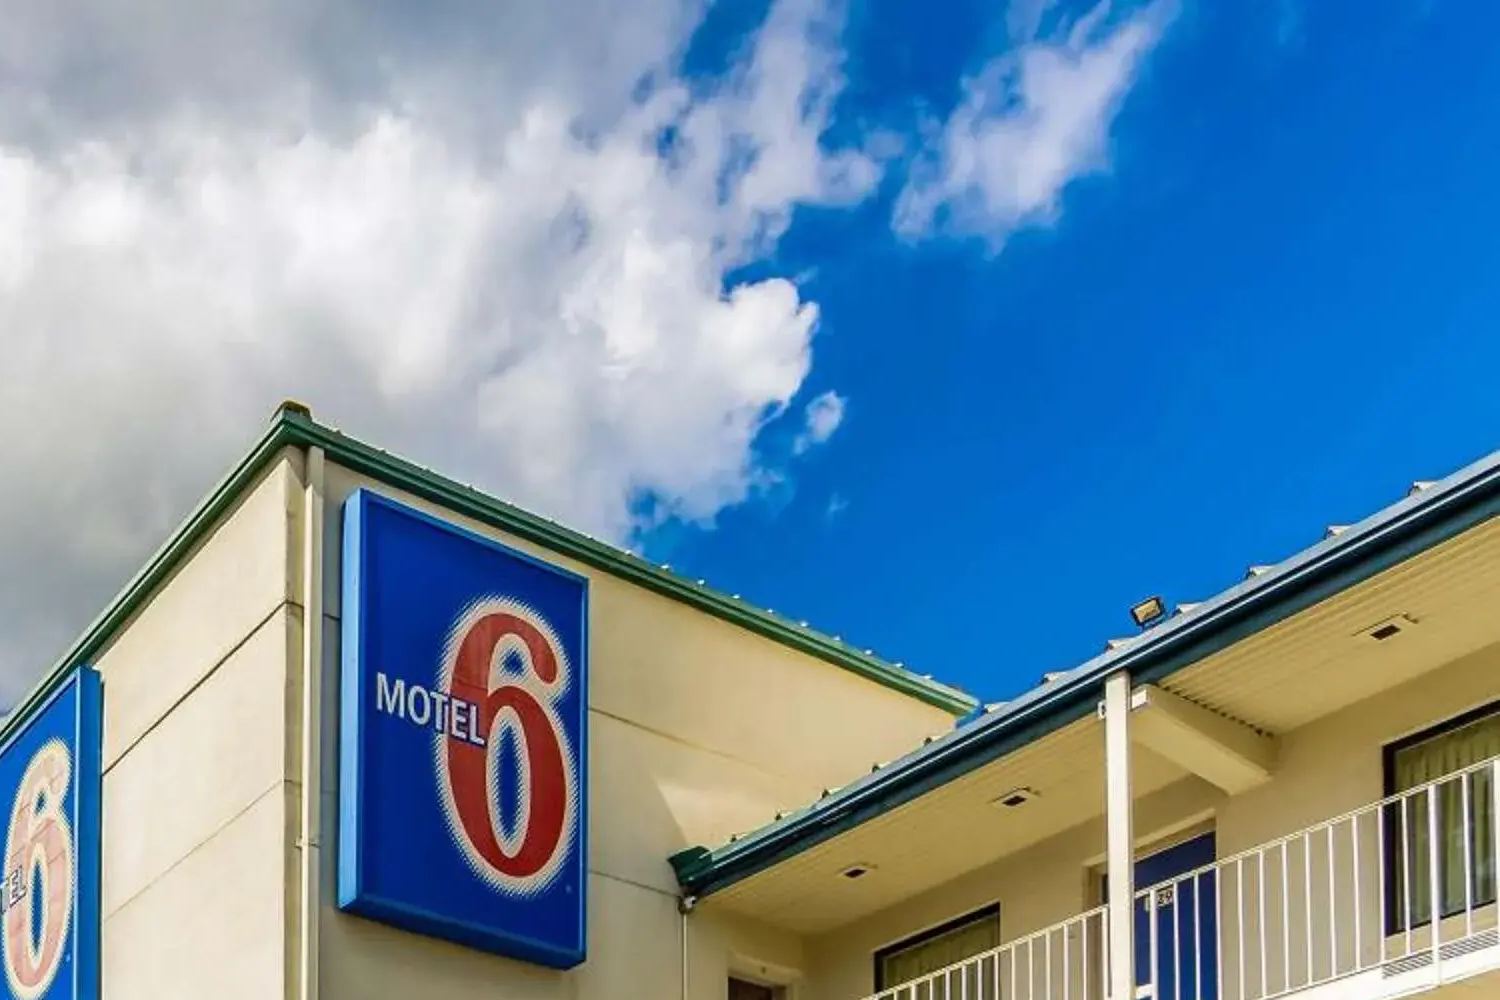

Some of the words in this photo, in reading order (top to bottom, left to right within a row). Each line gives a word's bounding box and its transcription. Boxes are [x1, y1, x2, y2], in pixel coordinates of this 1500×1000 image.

[3, 741, 70, 1000] 6
[376, 671, 486, 747] MOTEL
[442, 603, 573, 886] 6
